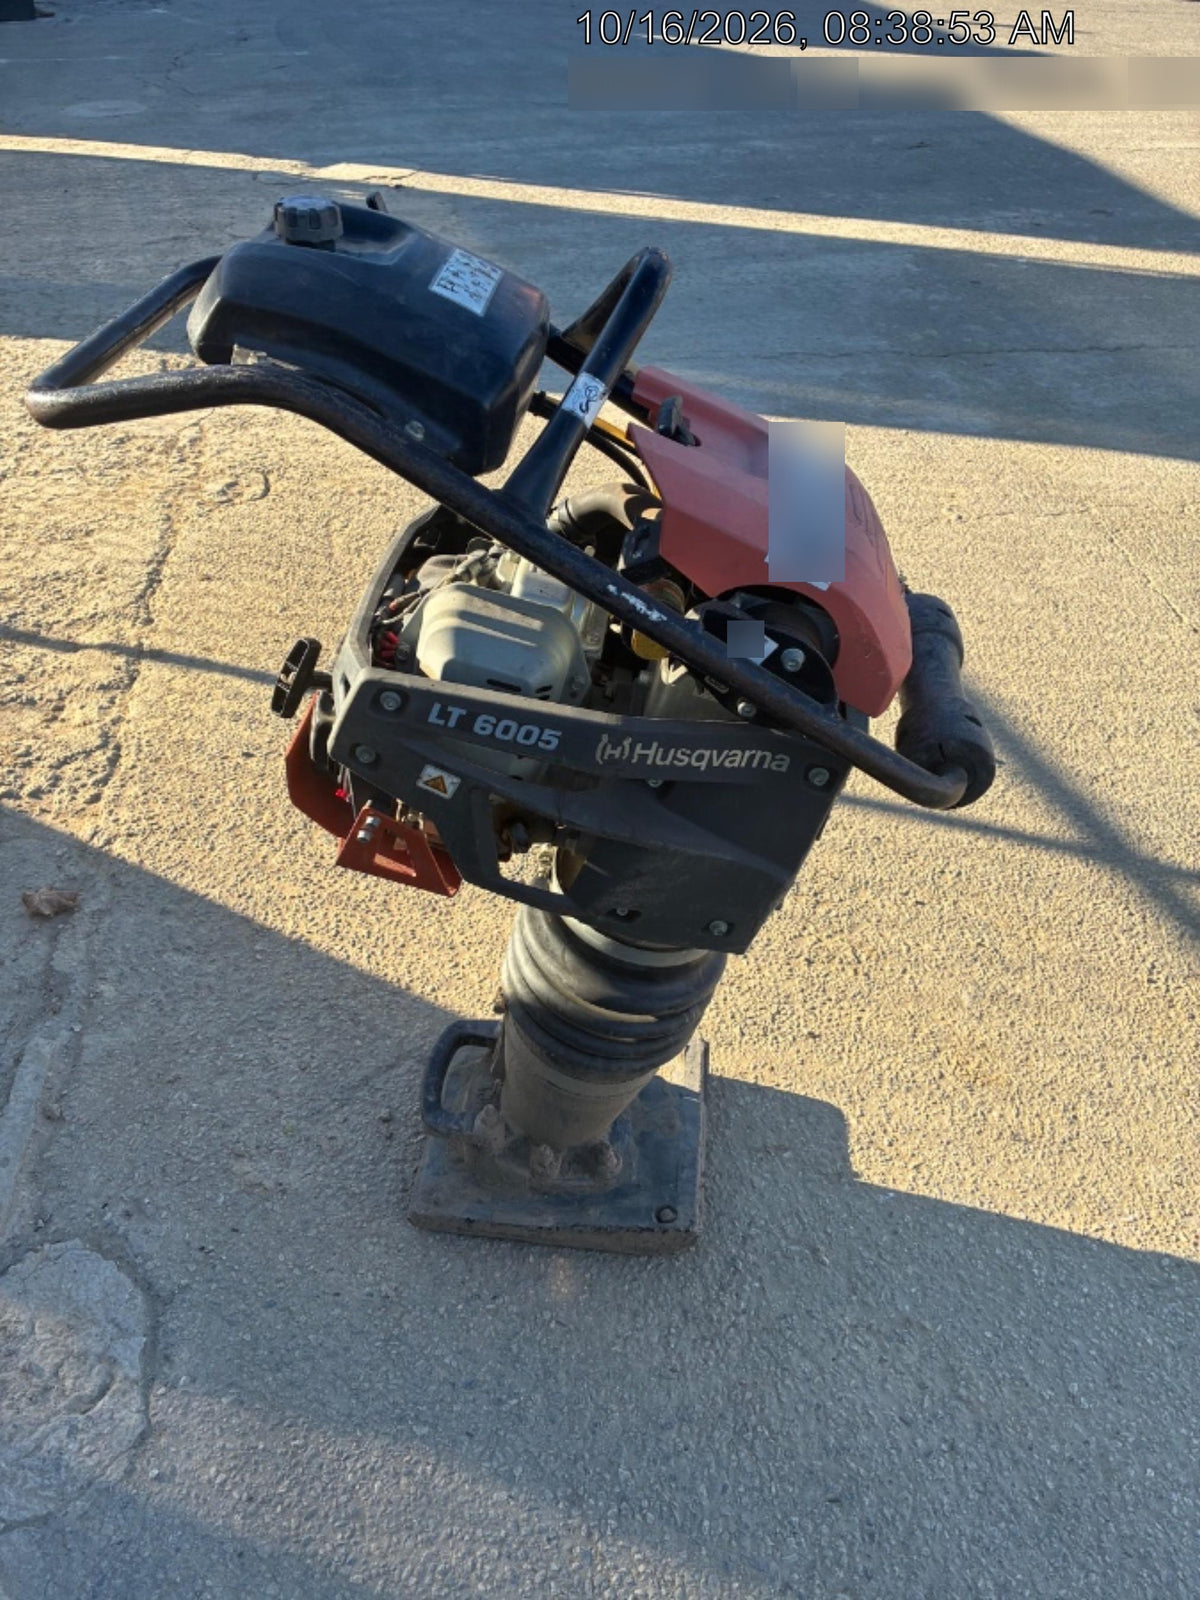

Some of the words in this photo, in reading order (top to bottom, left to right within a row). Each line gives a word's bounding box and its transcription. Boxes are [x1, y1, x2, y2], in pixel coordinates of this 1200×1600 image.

[428, 702, 467, 729] LT
[473, 713, 563, 752] 6005
[632, 741, 791, 773] Husqvarna
